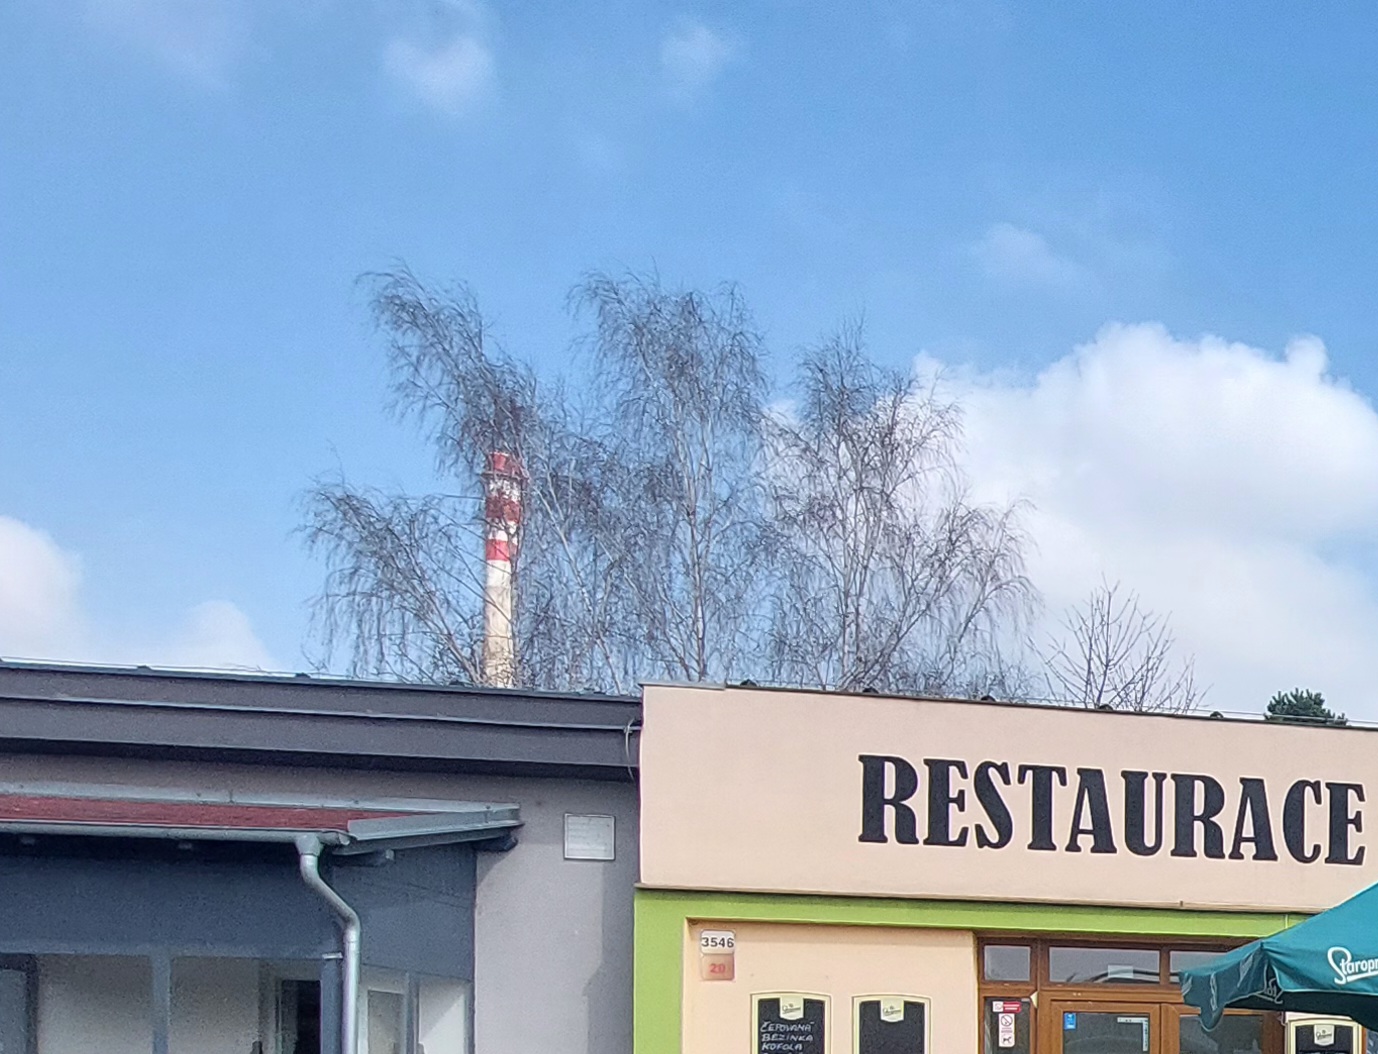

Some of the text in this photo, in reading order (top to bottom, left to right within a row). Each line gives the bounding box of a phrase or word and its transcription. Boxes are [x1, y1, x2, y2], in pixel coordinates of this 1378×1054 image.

[858, 755, 1366, 865] RESTAURACE
[701, 937, 734, 948] 3546
[761, 1042, 803, 1051] KOFOLA
